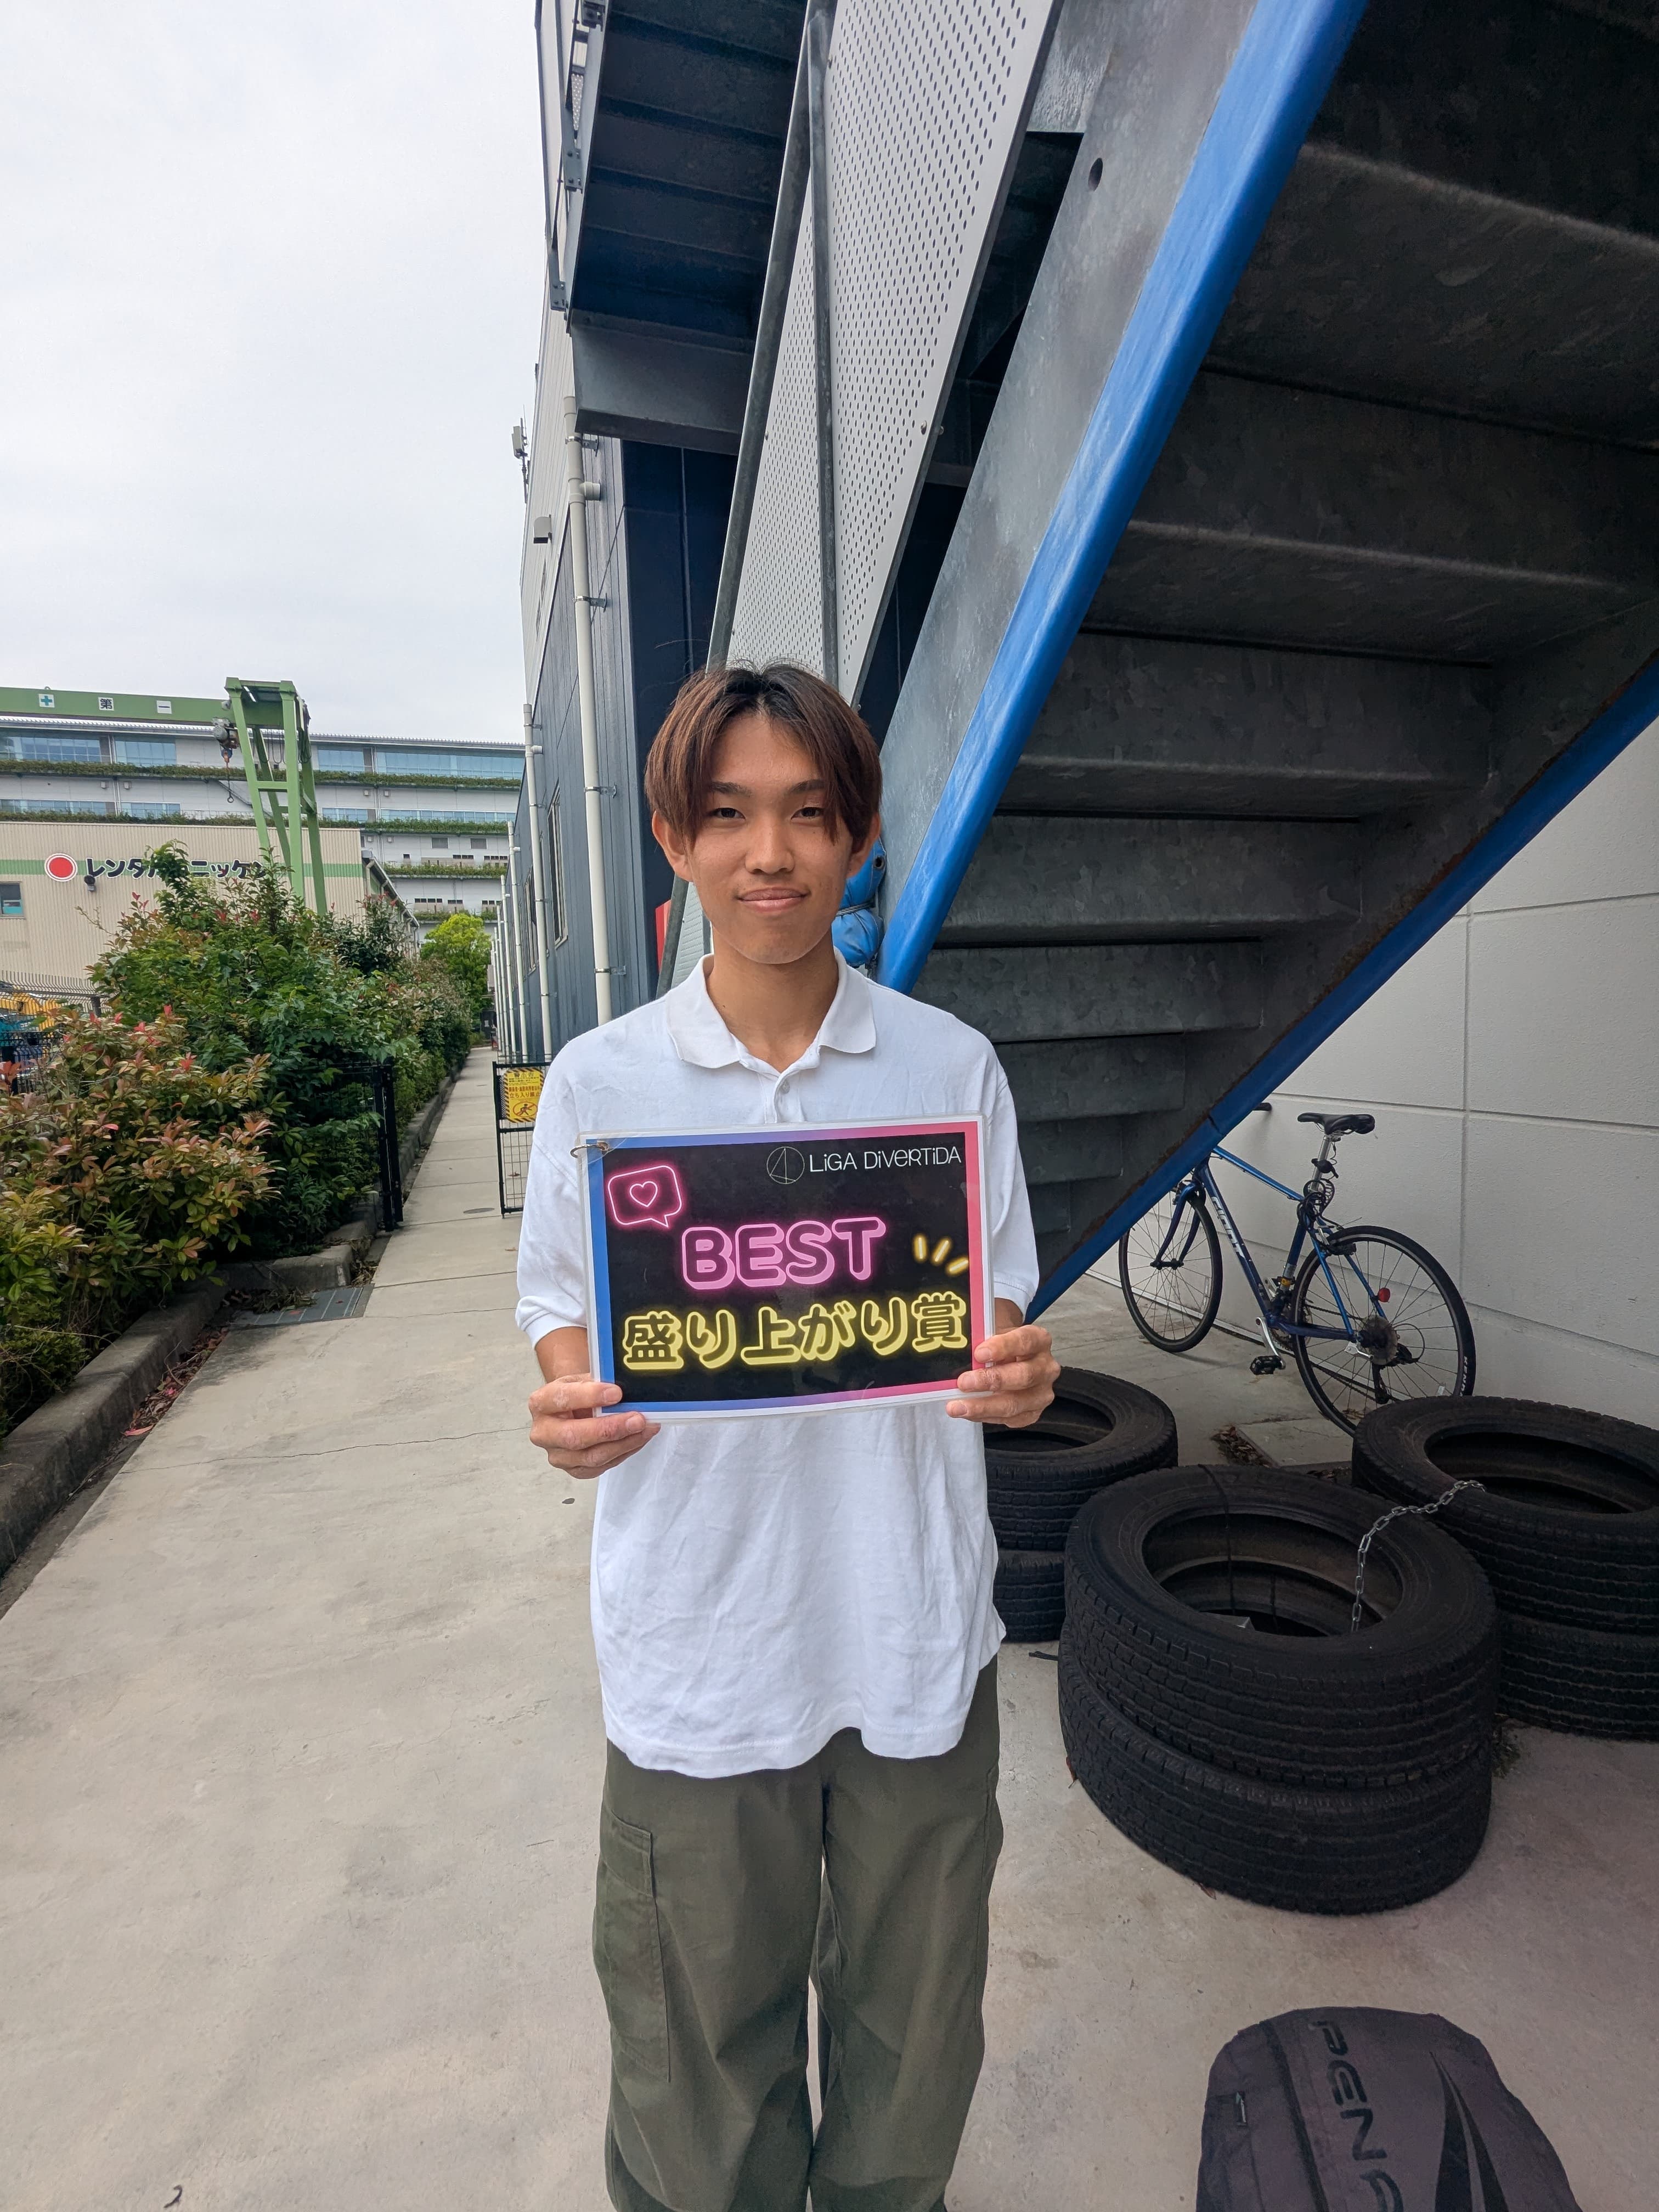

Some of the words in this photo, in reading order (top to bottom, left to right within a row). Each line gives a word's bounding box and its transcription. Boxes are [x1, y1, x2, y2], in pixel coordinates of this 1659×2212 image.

[681, 1216, 886, 1289] BEST
[623, 1291, 968, 1370] 盛り上がり賞
